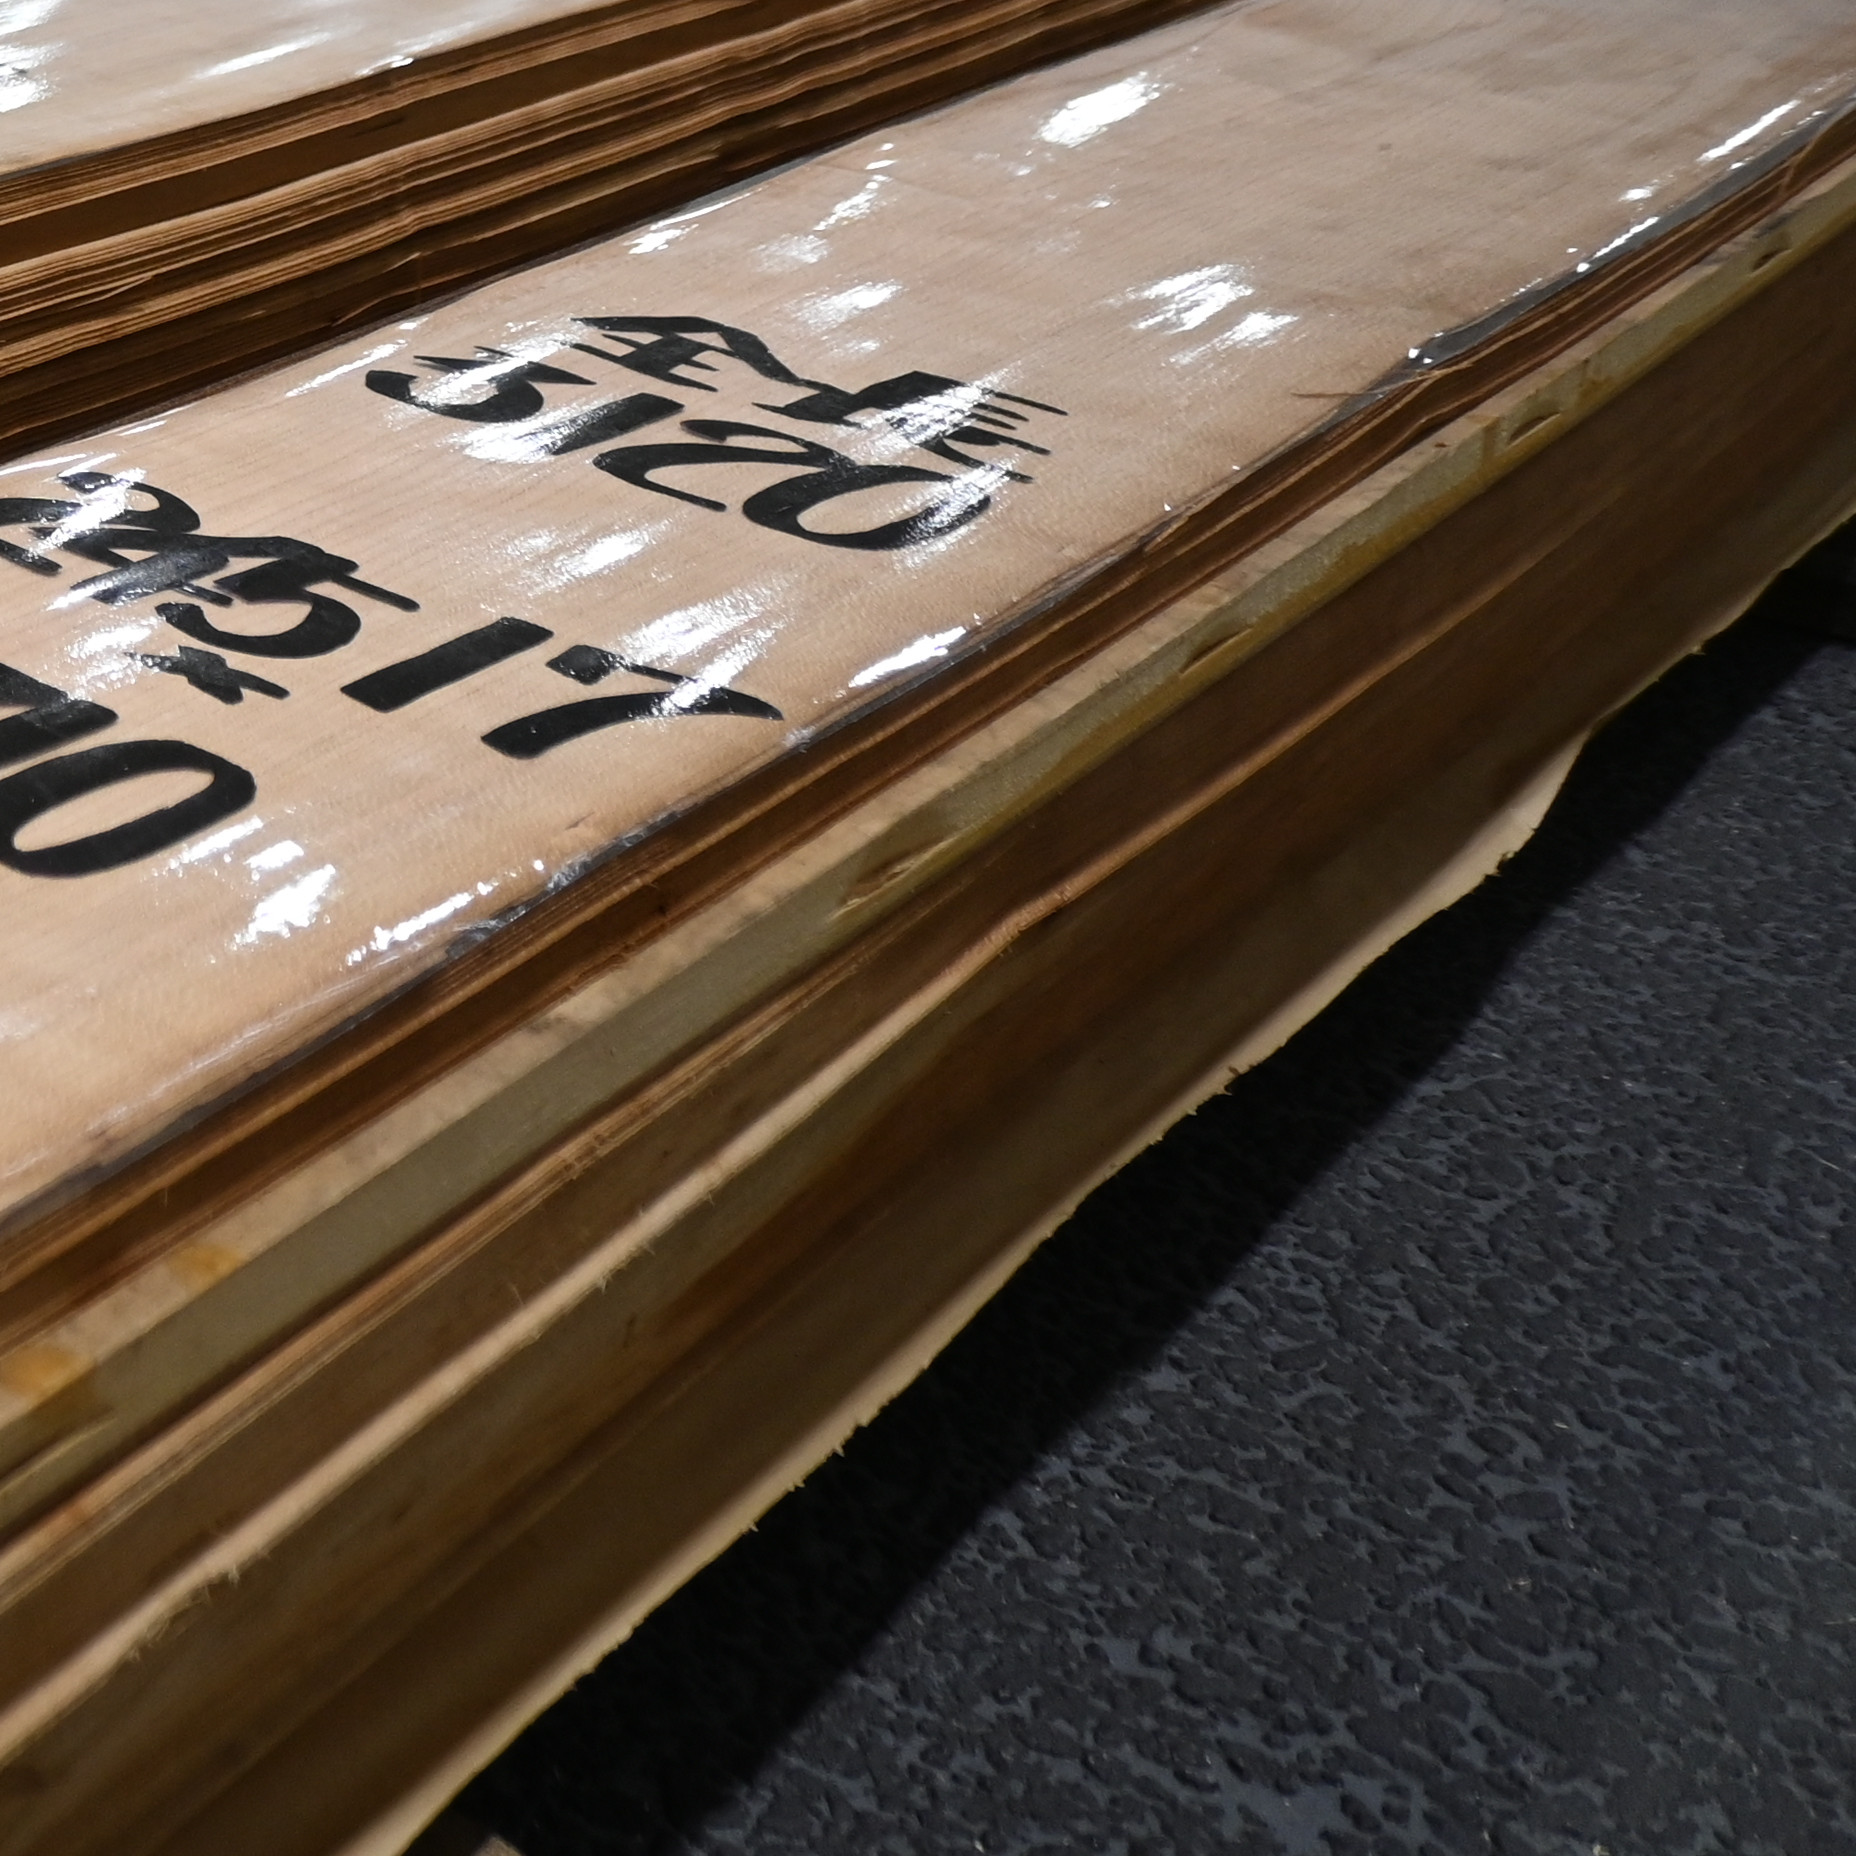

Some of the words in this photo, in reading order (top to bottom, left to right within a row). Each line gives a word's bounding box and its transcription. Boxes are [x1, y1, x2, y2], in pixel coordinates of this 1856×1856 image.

[365, 350, 992, 549] 3120
[573, 314, 1068, 482] 全長
[340, 615, 786, 760] 17
